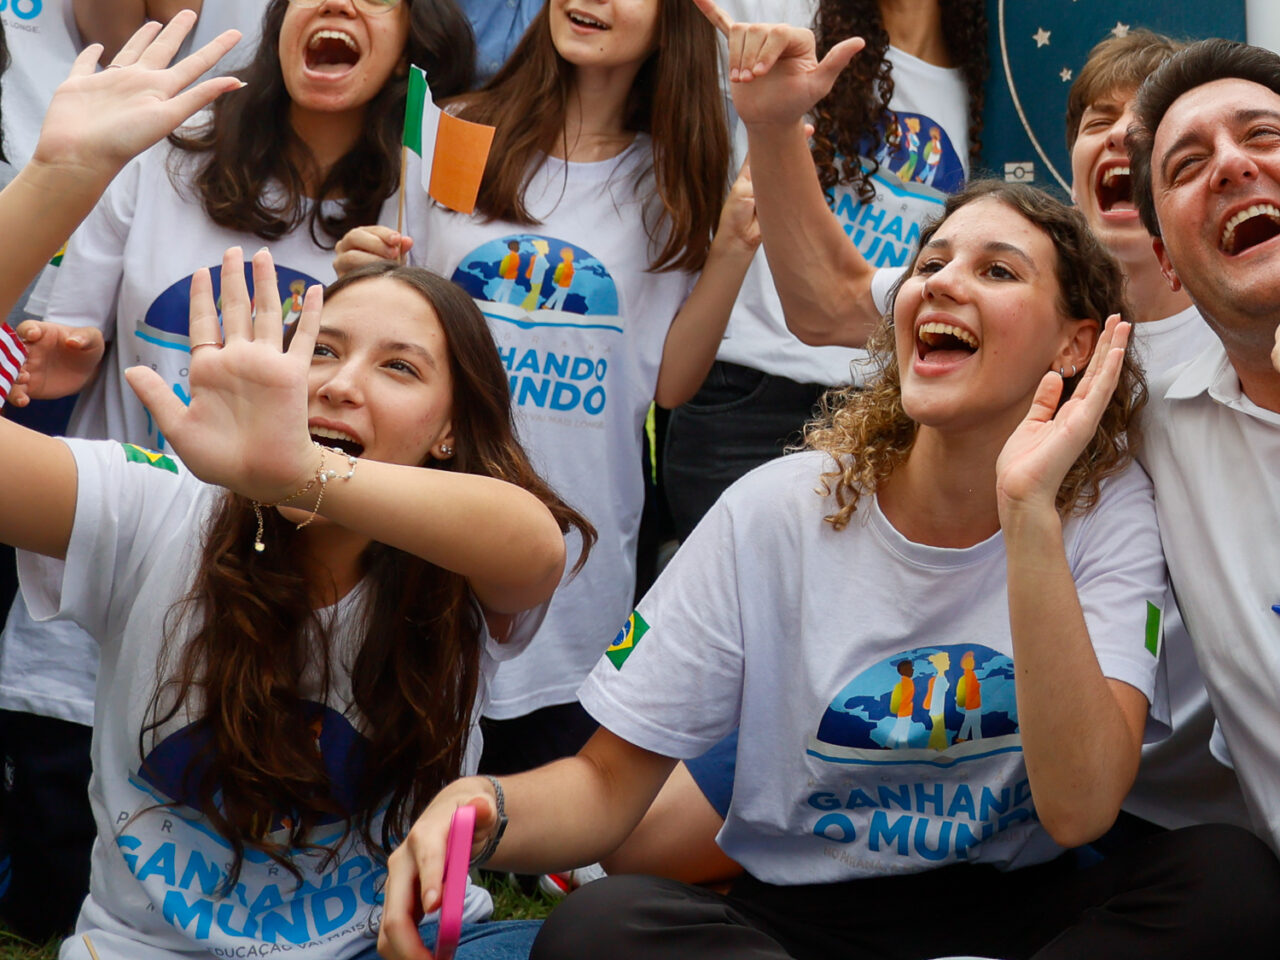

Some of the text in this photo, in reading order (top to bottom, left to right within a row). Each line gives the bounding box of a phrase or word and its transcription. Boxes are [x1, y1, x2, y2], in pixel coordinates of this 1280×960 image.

[826, 187, 921, 245] NHAN
[498, 346, 608, 382] HANDO
[508, 375, 606, 416] NDO
[807, 778, 1032, 824] GANHAND
[813, 812, 857, 844] O
